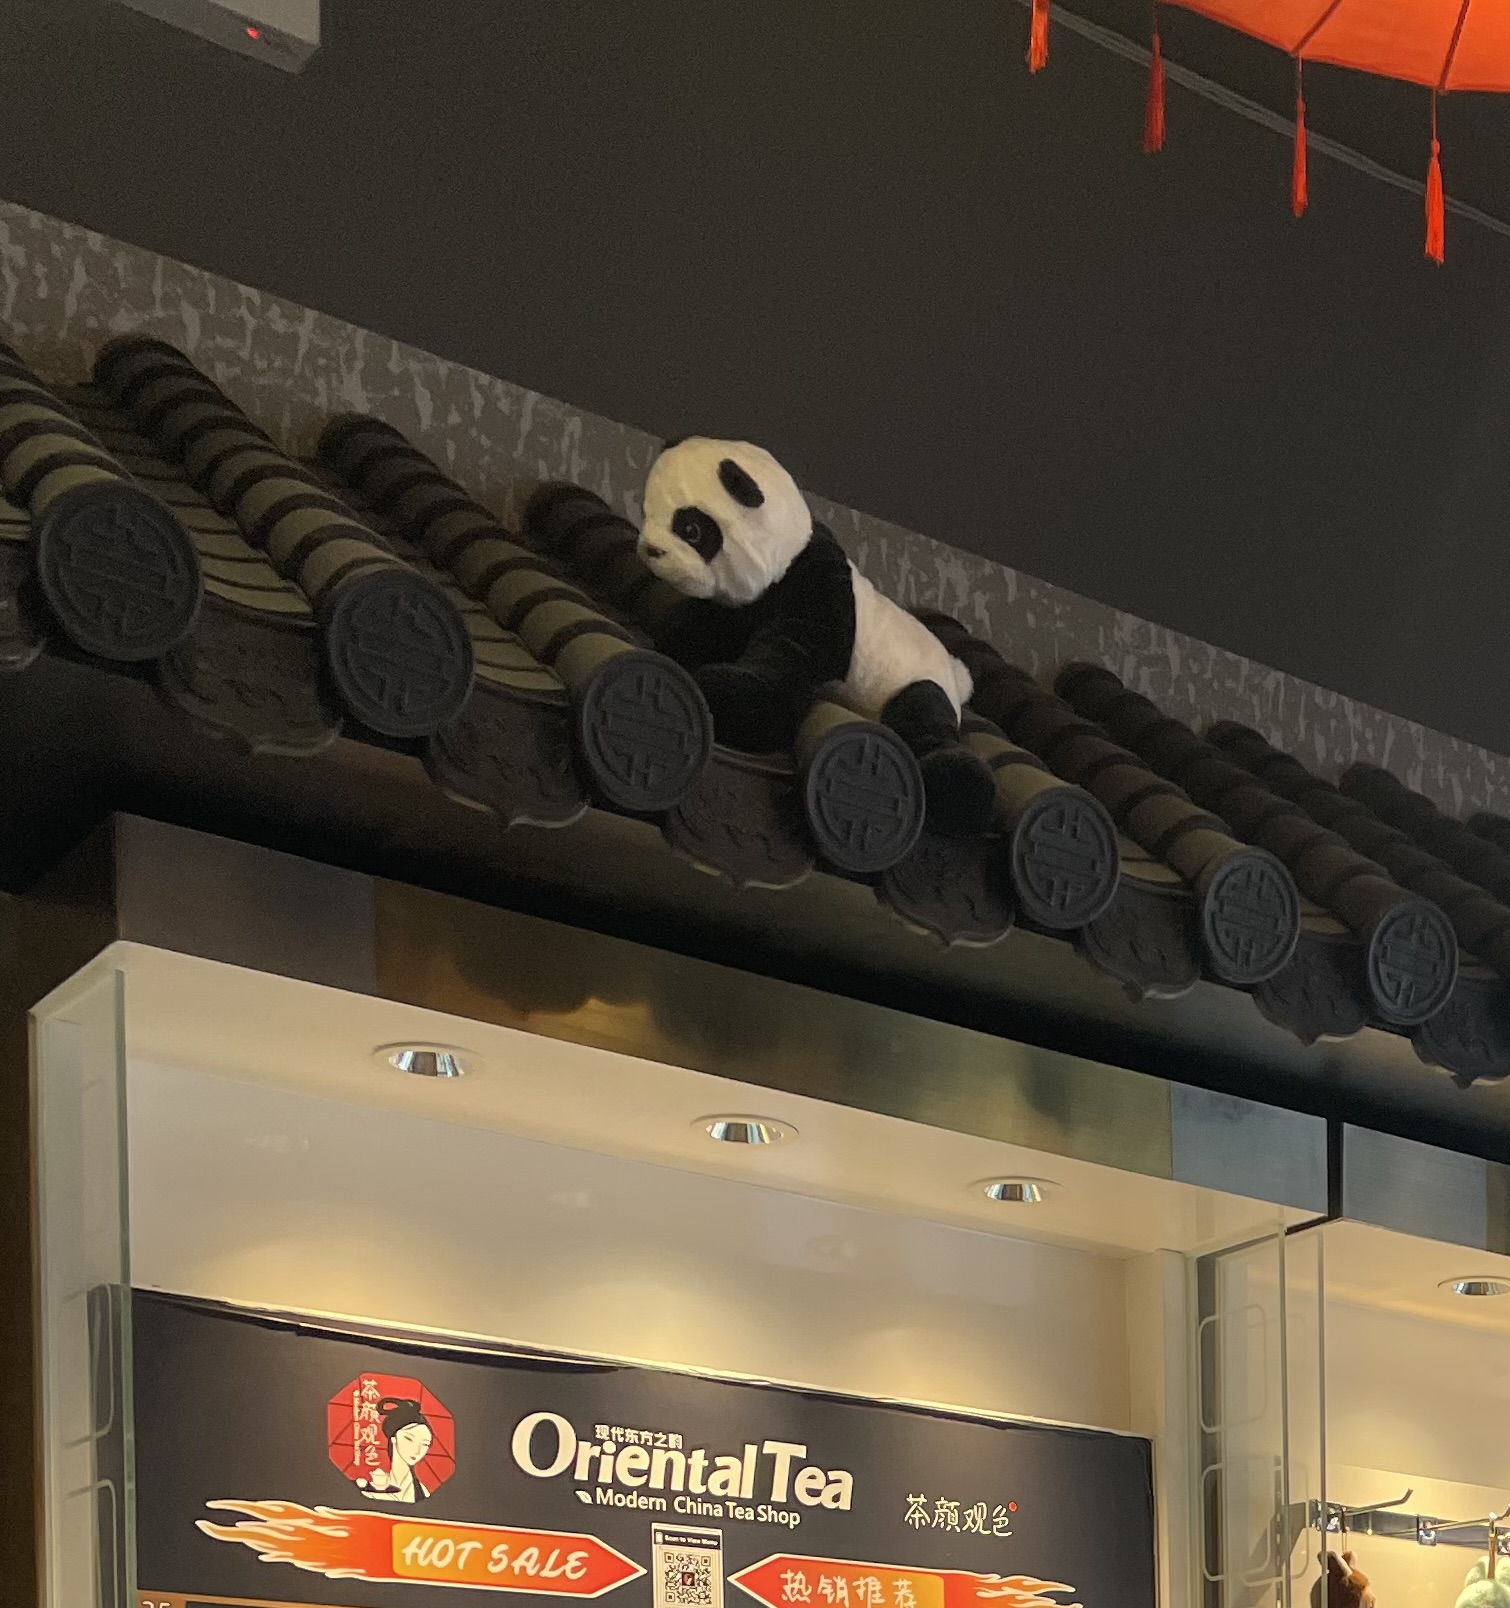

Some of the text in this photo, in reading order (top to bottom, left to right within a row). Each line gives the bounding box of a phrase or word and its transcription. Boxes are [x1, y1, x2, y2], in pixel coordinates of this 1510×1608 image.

[511, 1411, 854, 1511] Oriental Tea
[595, 1491, 801, 1529] Modern China Tea Shop
[904, 1493, 1014, 1537] 茶颜观色
[402, 1535, 590, 1580] HOT SALE
